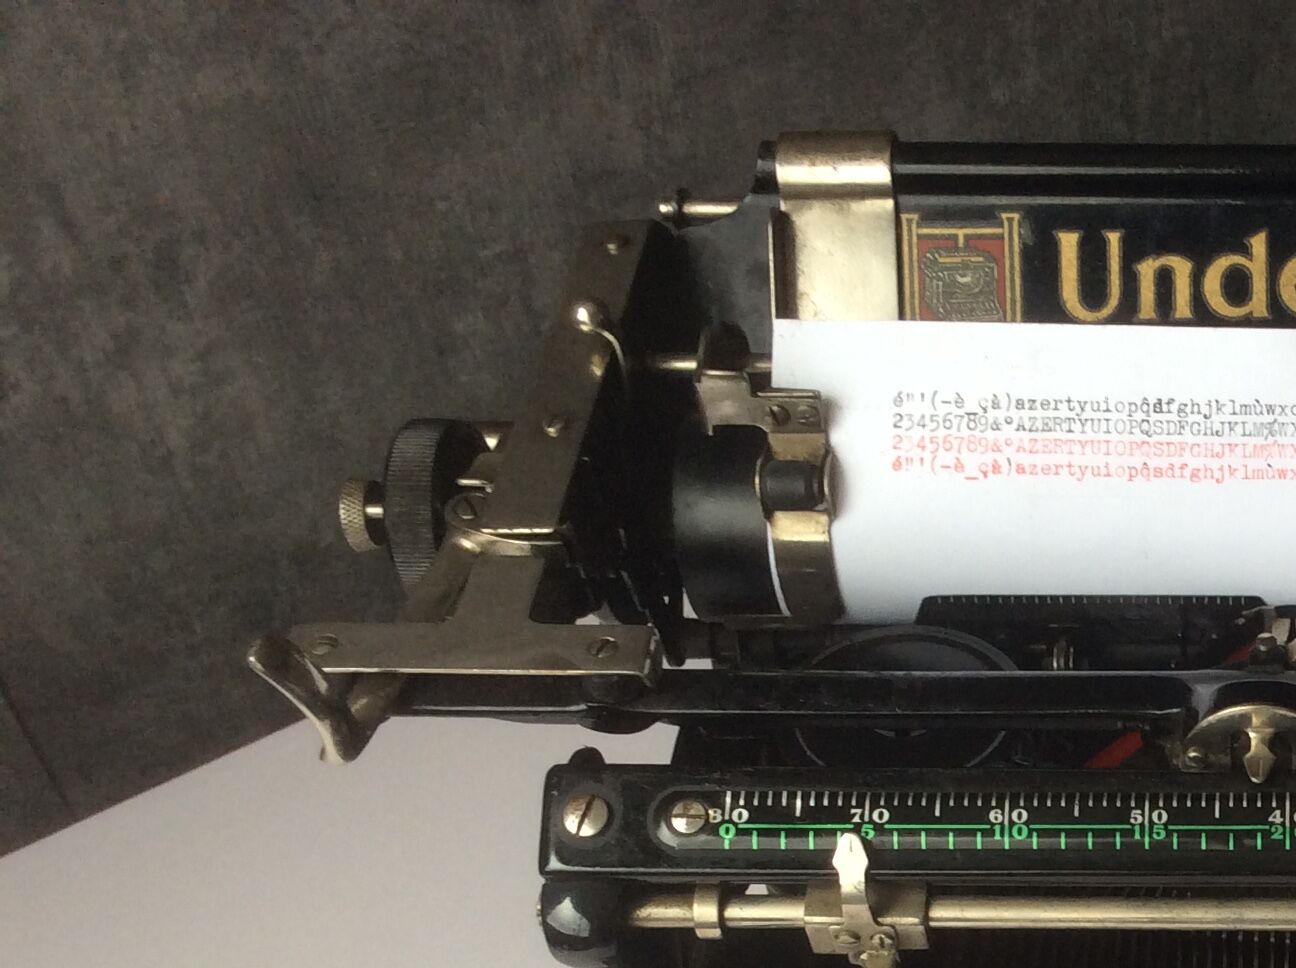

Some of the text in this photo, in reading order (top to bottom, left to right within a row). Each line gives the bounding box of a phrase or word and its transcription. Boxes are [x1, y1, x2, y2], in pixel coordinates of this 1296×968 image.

[850, 808, 890, 823] 70
[988, 808, 1028, 823] 60
[1129, 809, 1168, 824] 50
